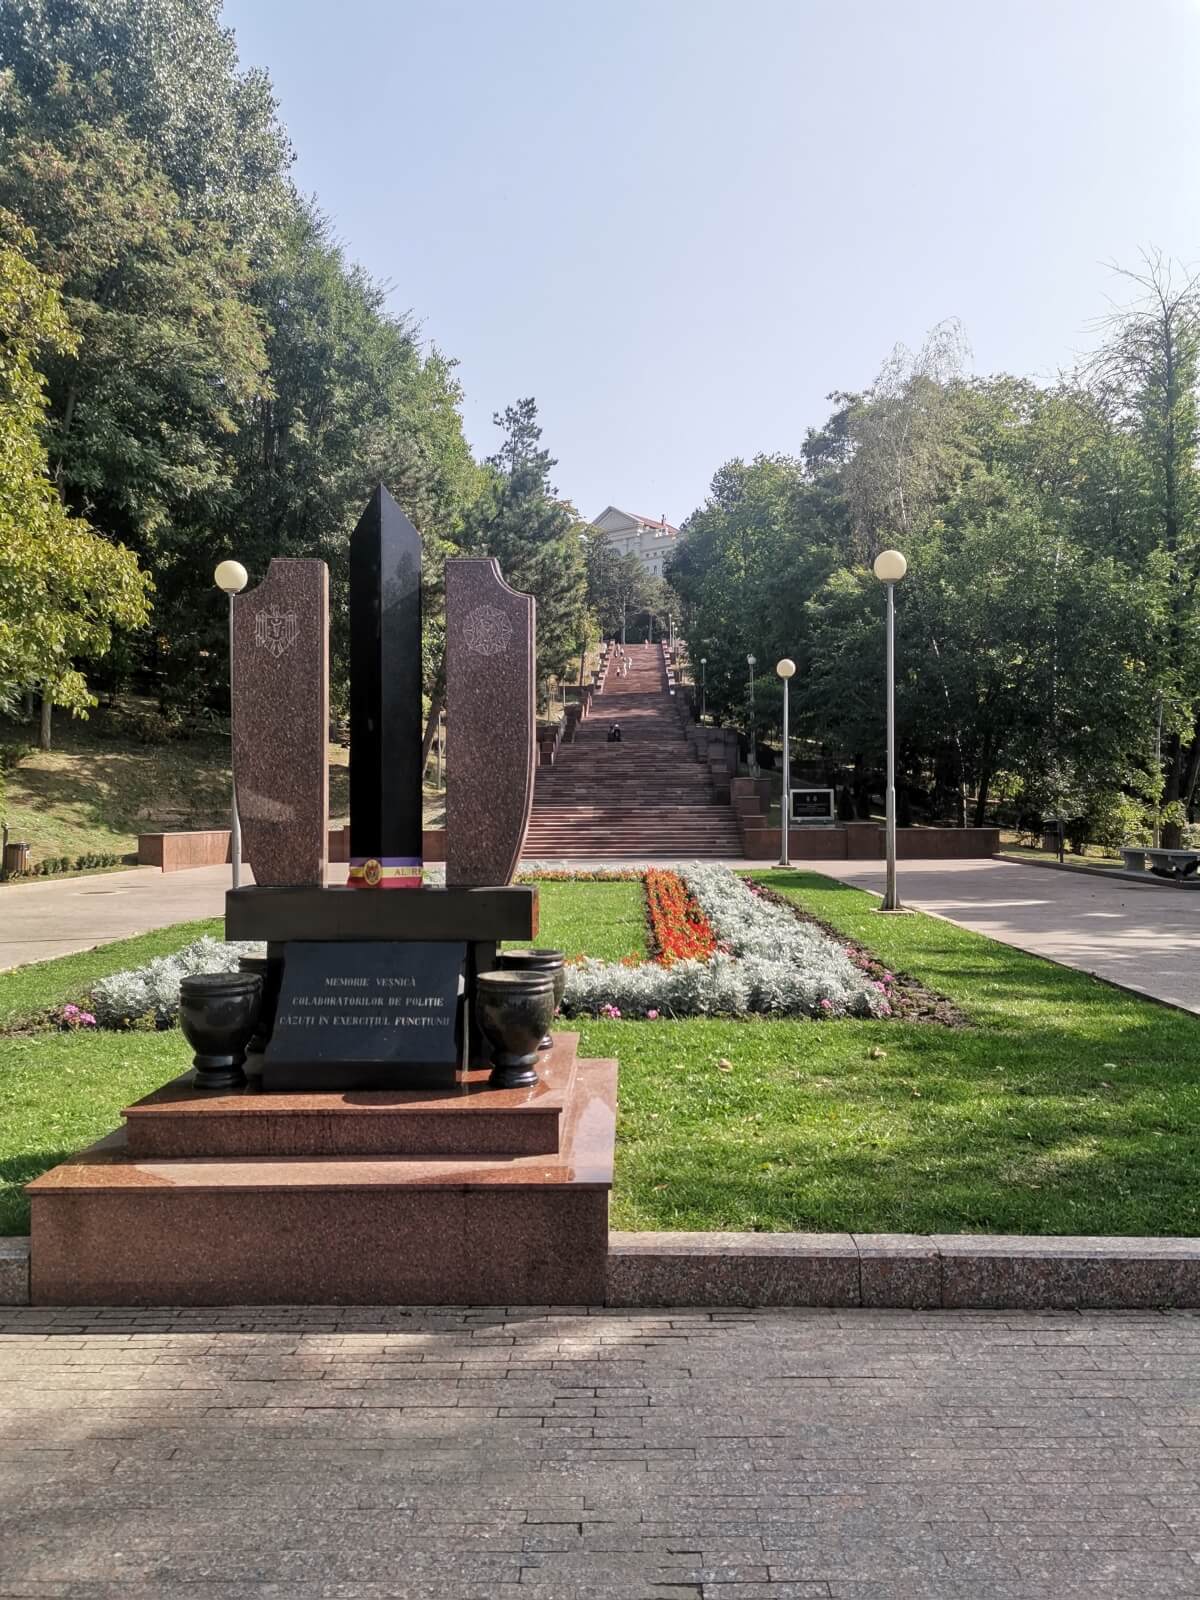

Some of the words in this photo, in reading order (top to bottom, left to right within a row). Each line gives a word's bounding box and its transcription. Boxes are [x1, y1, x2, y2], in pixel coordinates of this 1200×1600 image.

[325, 977, 369, 987] MEMORIE
[292, 996, 384, 1007] COLABORATORILOR
[388, 996, 402, 1007] DE
